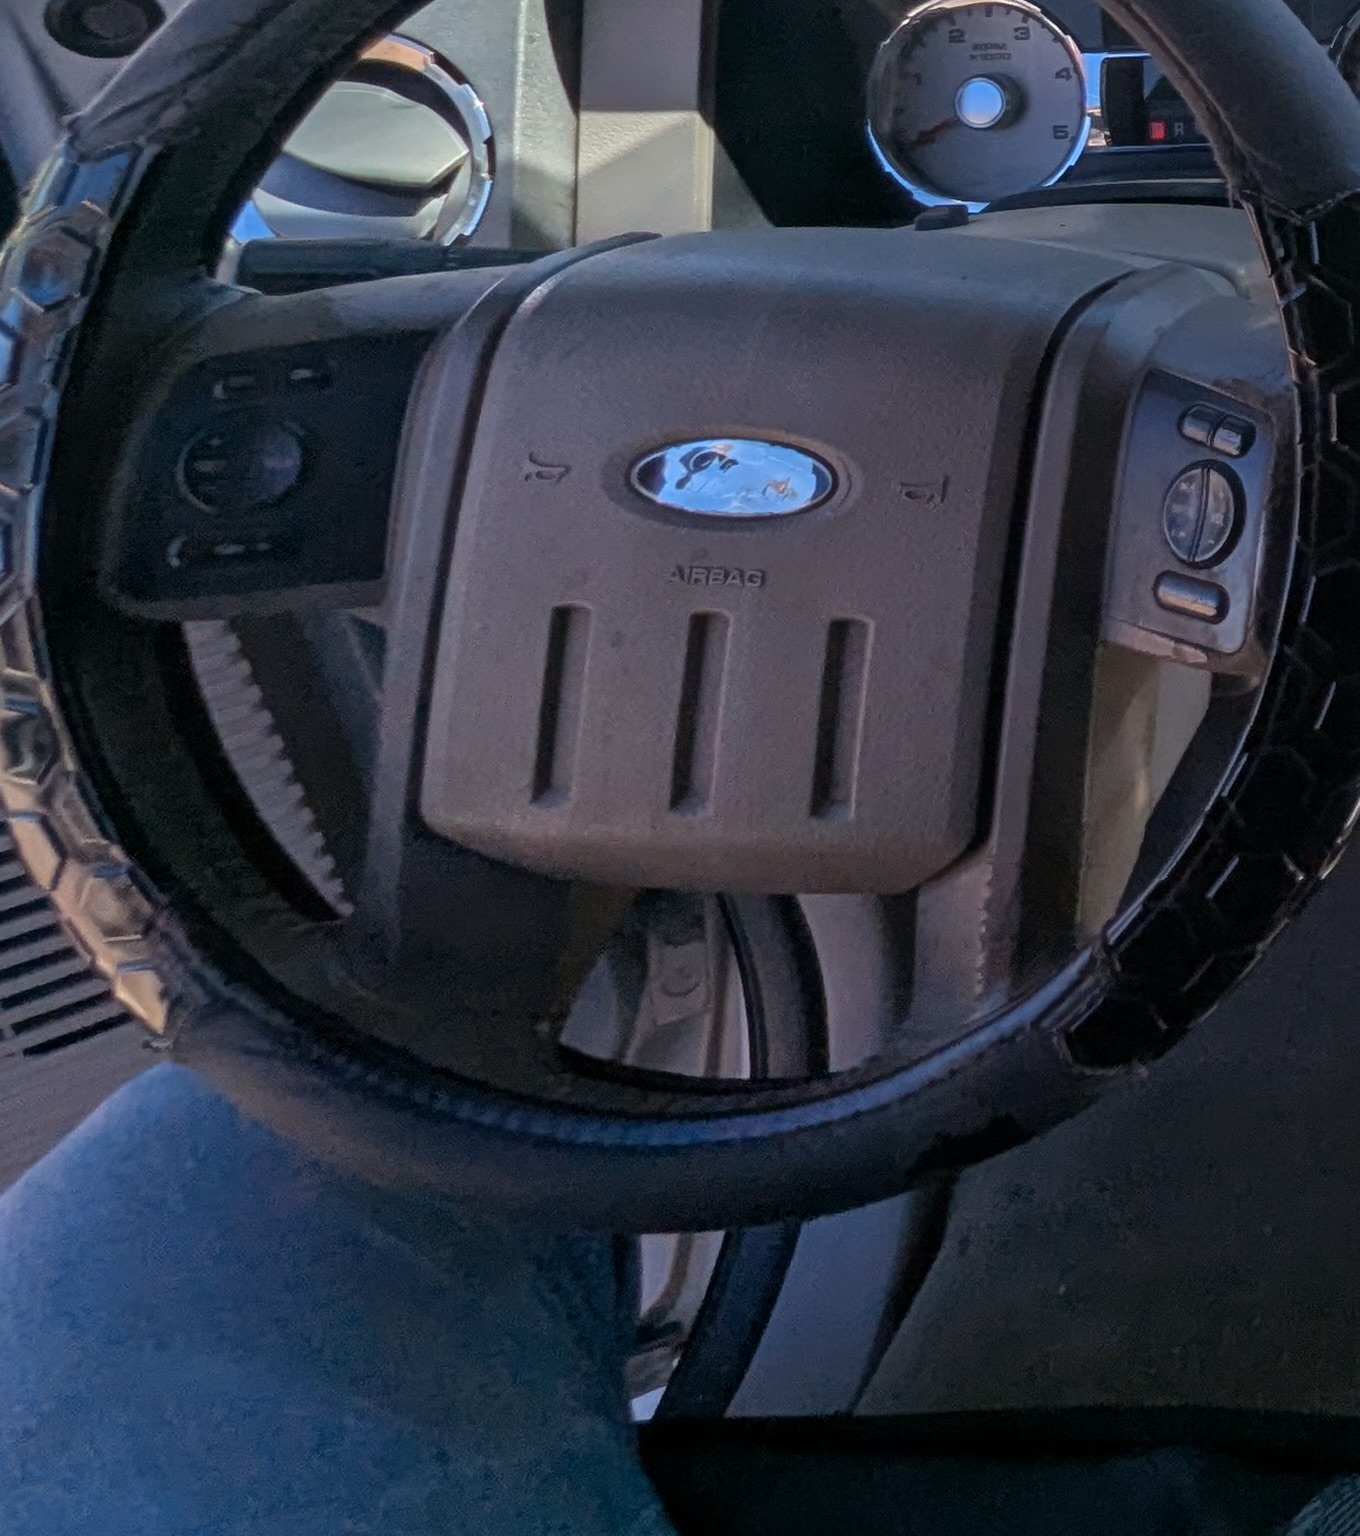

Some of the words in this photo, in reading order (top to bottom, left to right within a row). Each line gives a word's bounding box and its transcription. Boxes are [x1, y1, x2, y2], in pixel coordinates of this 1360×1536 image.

[948, 28, 966, 44] 2
[1013, 26, 1031, 41] 3
[1054, 67, 1073, 82] 4
[1053, 124, 1069, 140] 5
[665, 564, 768, 588] AIRBAG
